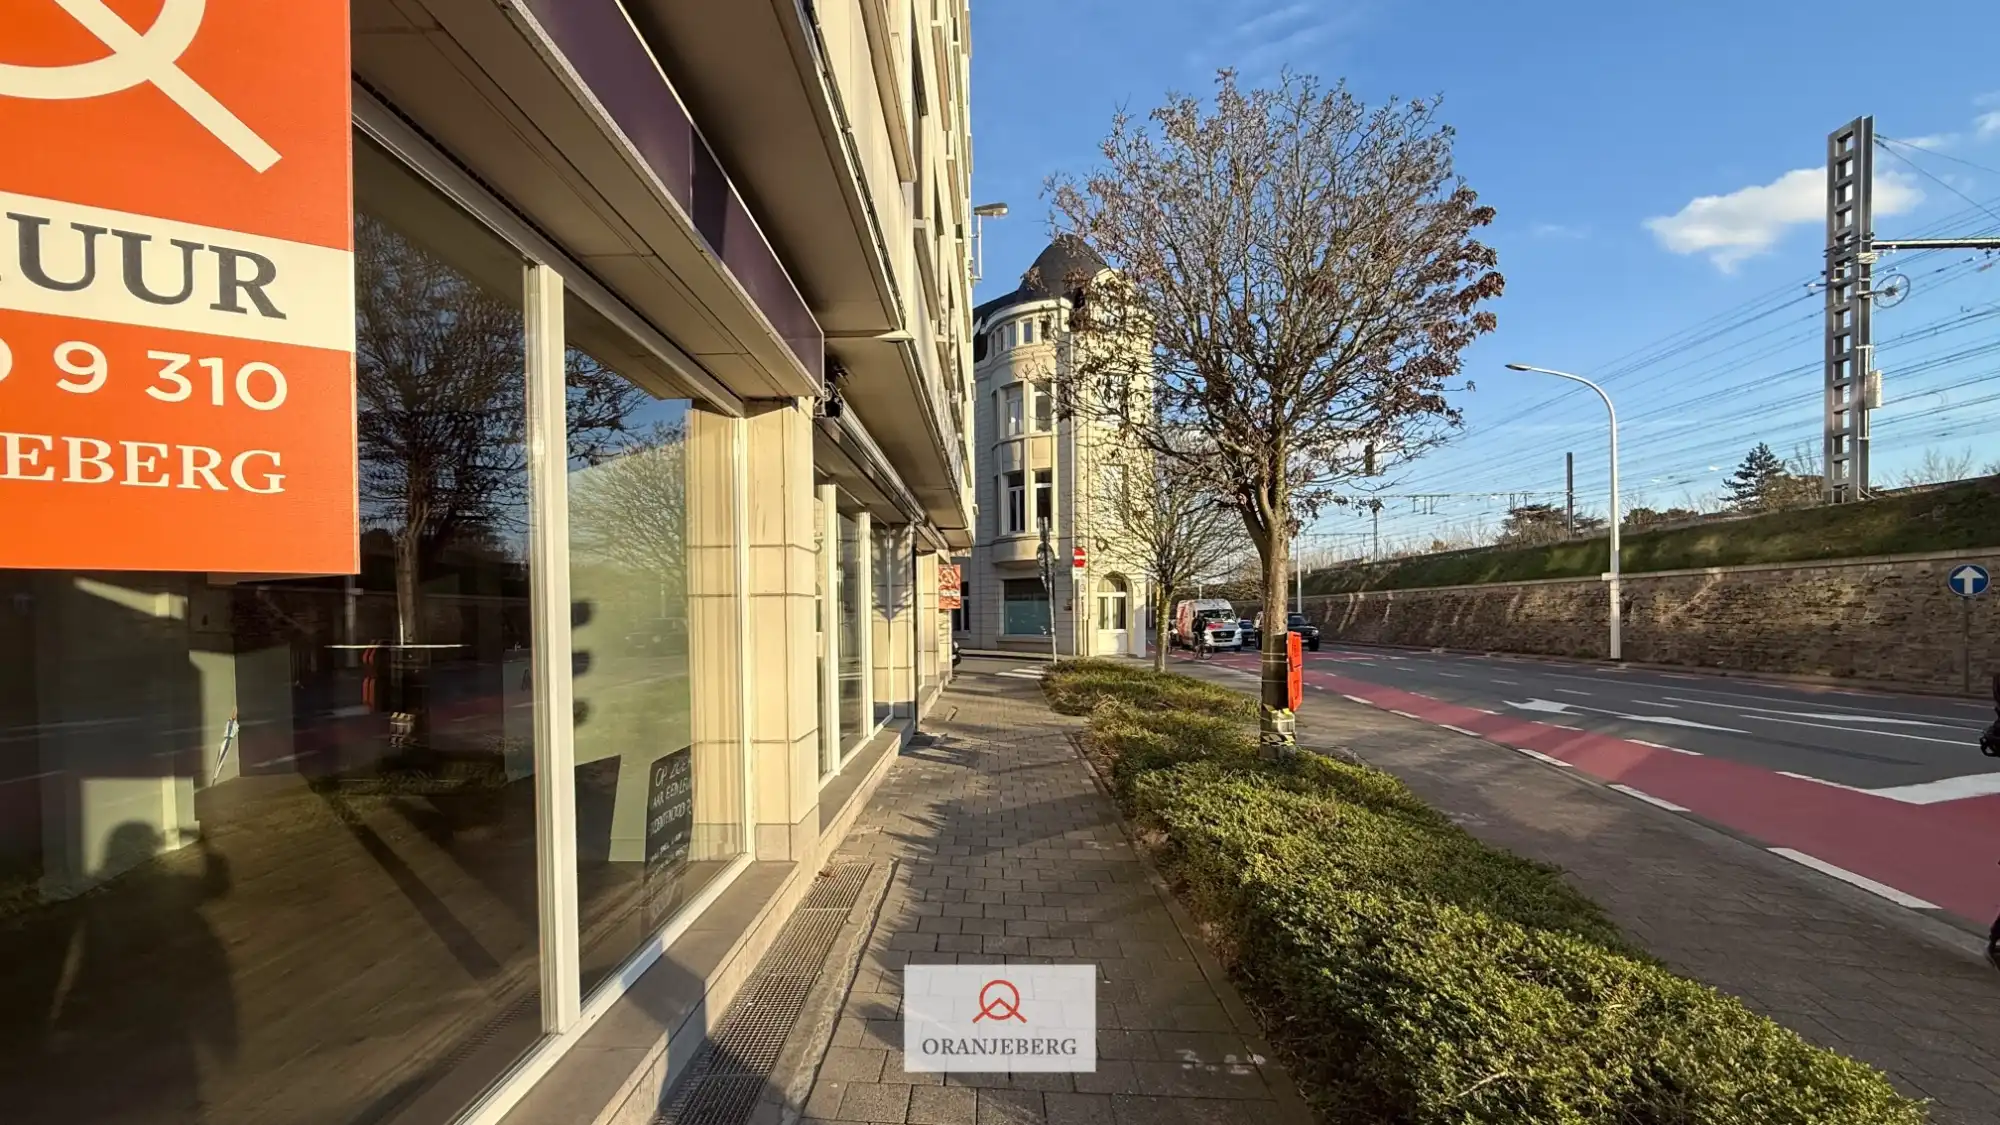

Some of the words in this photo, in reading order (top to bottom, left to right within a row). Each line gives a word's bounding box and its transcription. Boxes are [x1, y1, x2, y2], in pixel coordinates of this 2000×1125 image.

[0, 211, 287, 320] UUR
[53, 340, 108, 394] 9
[145, 349, 288, 411] 310
